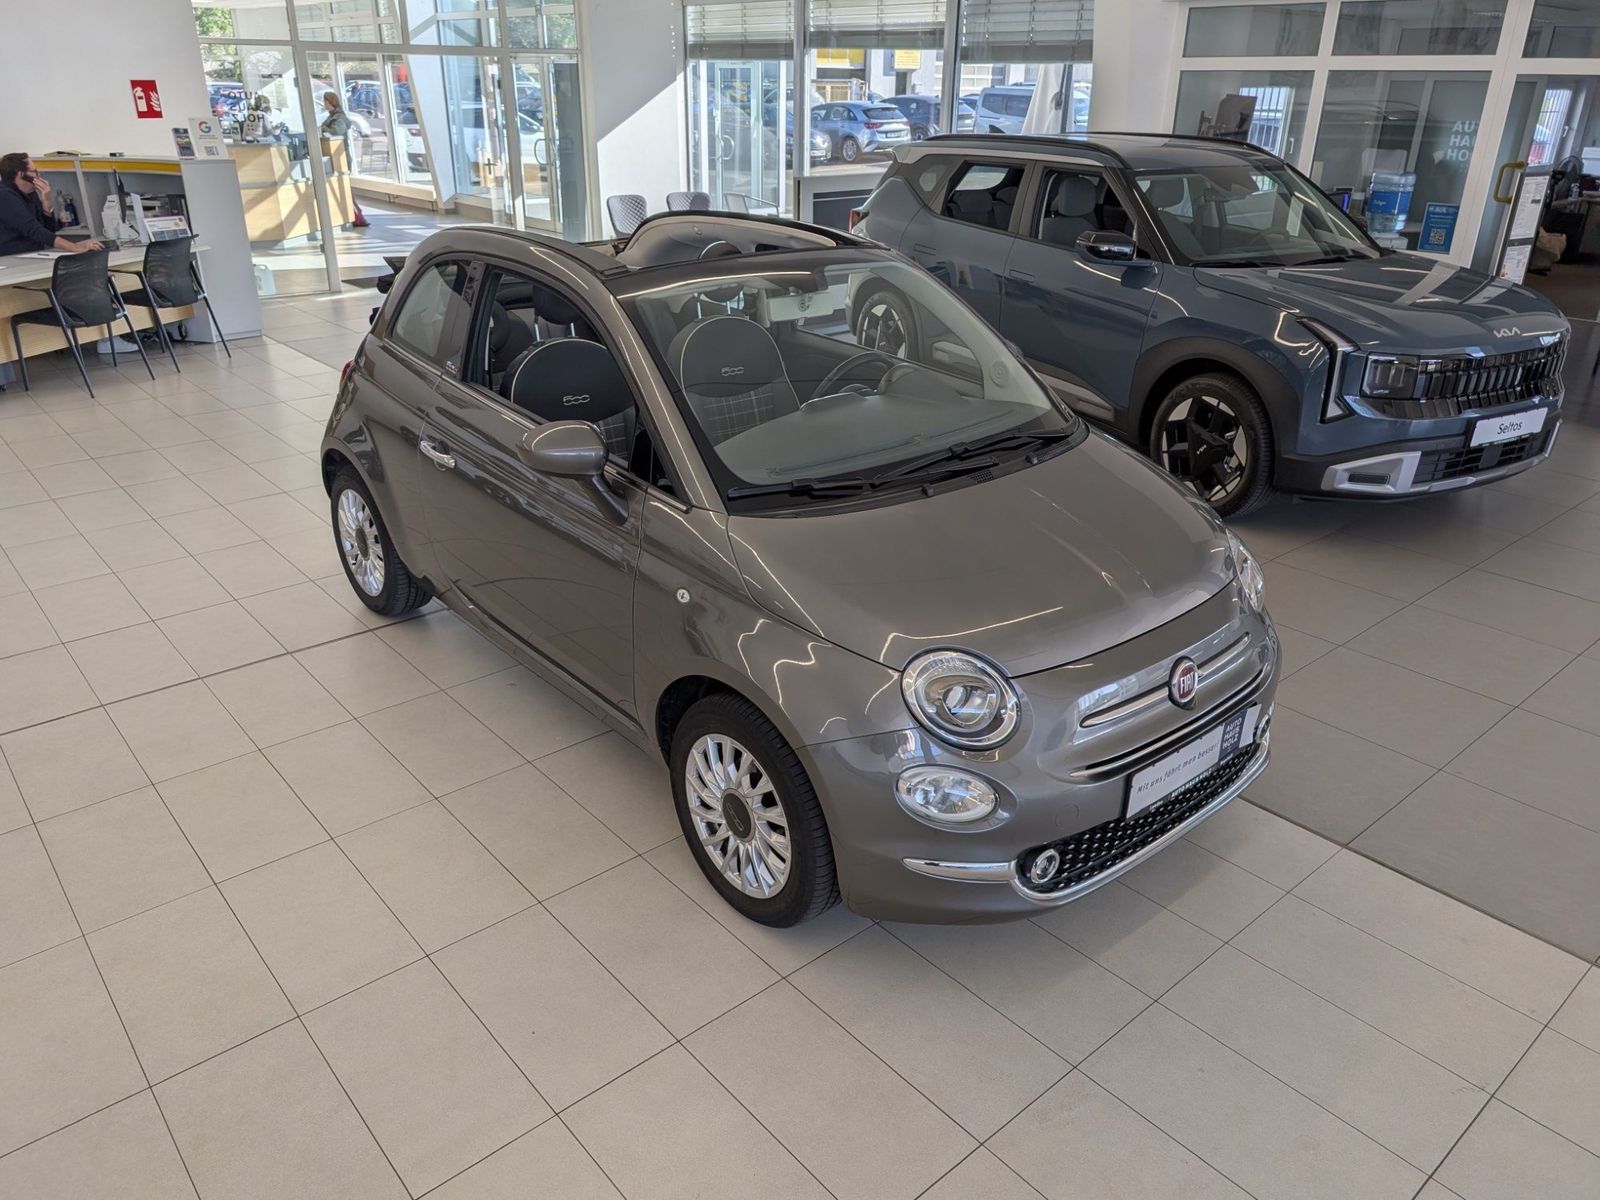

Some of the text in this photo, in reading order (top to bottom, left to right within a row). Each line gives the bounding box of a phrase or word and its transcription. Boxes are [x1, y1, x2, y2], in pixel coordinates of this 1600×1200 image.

[1452, 120, 1480, 132] AU
[563, 394, 590, 405] 500
[1497, 420, 1523, 435] Seltos
[1180, 671, 1195, 694] FIAT
[1226, 718, 1242, 732] AUTO
